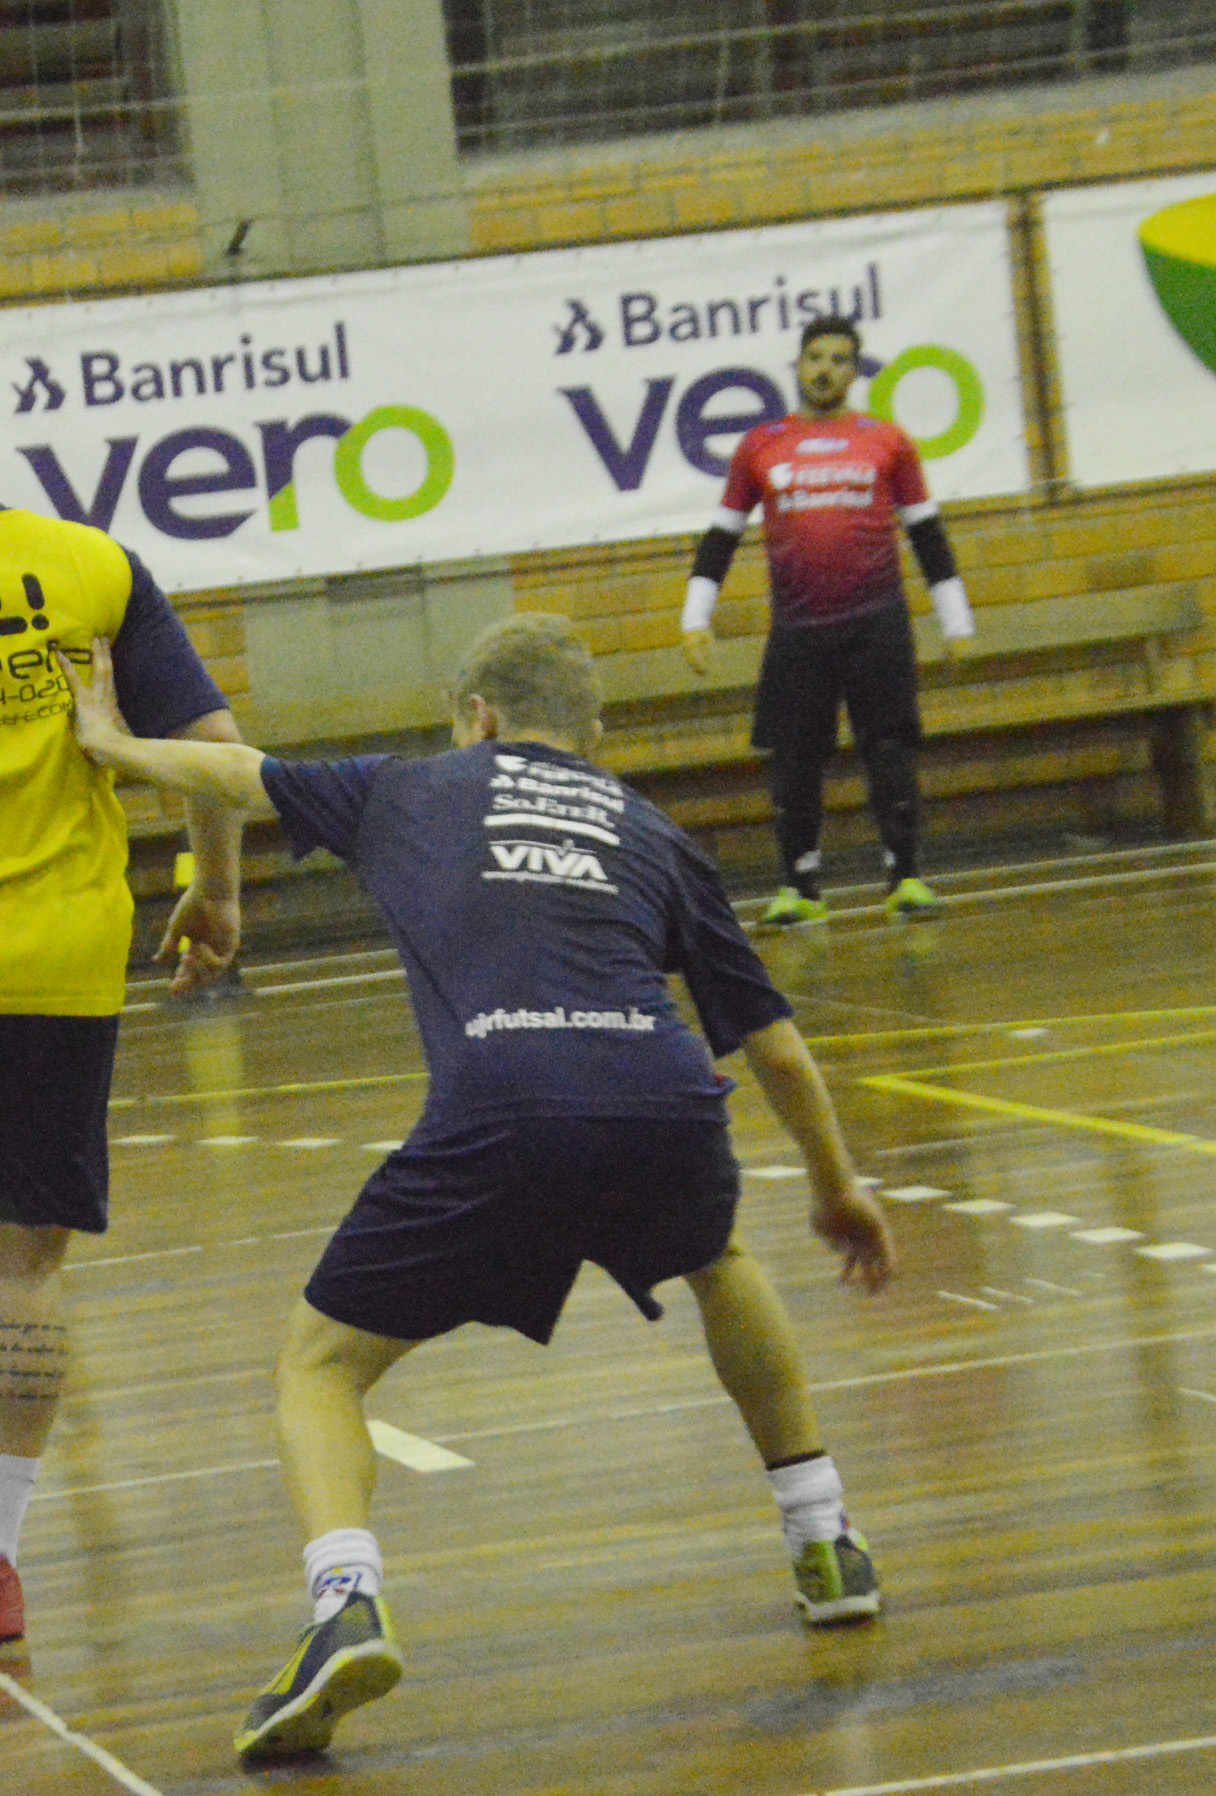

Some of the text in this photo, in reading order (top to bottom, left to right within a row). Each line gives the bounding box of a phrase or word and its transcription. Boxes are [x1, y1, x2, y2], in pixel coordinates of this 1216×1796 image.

[620, 261, 883, 348] Banrisul
[80, 320, 351, 408] Banrisul
[15, 403, 457, 541] vero
[489, 844, 610, 882] VIVA
